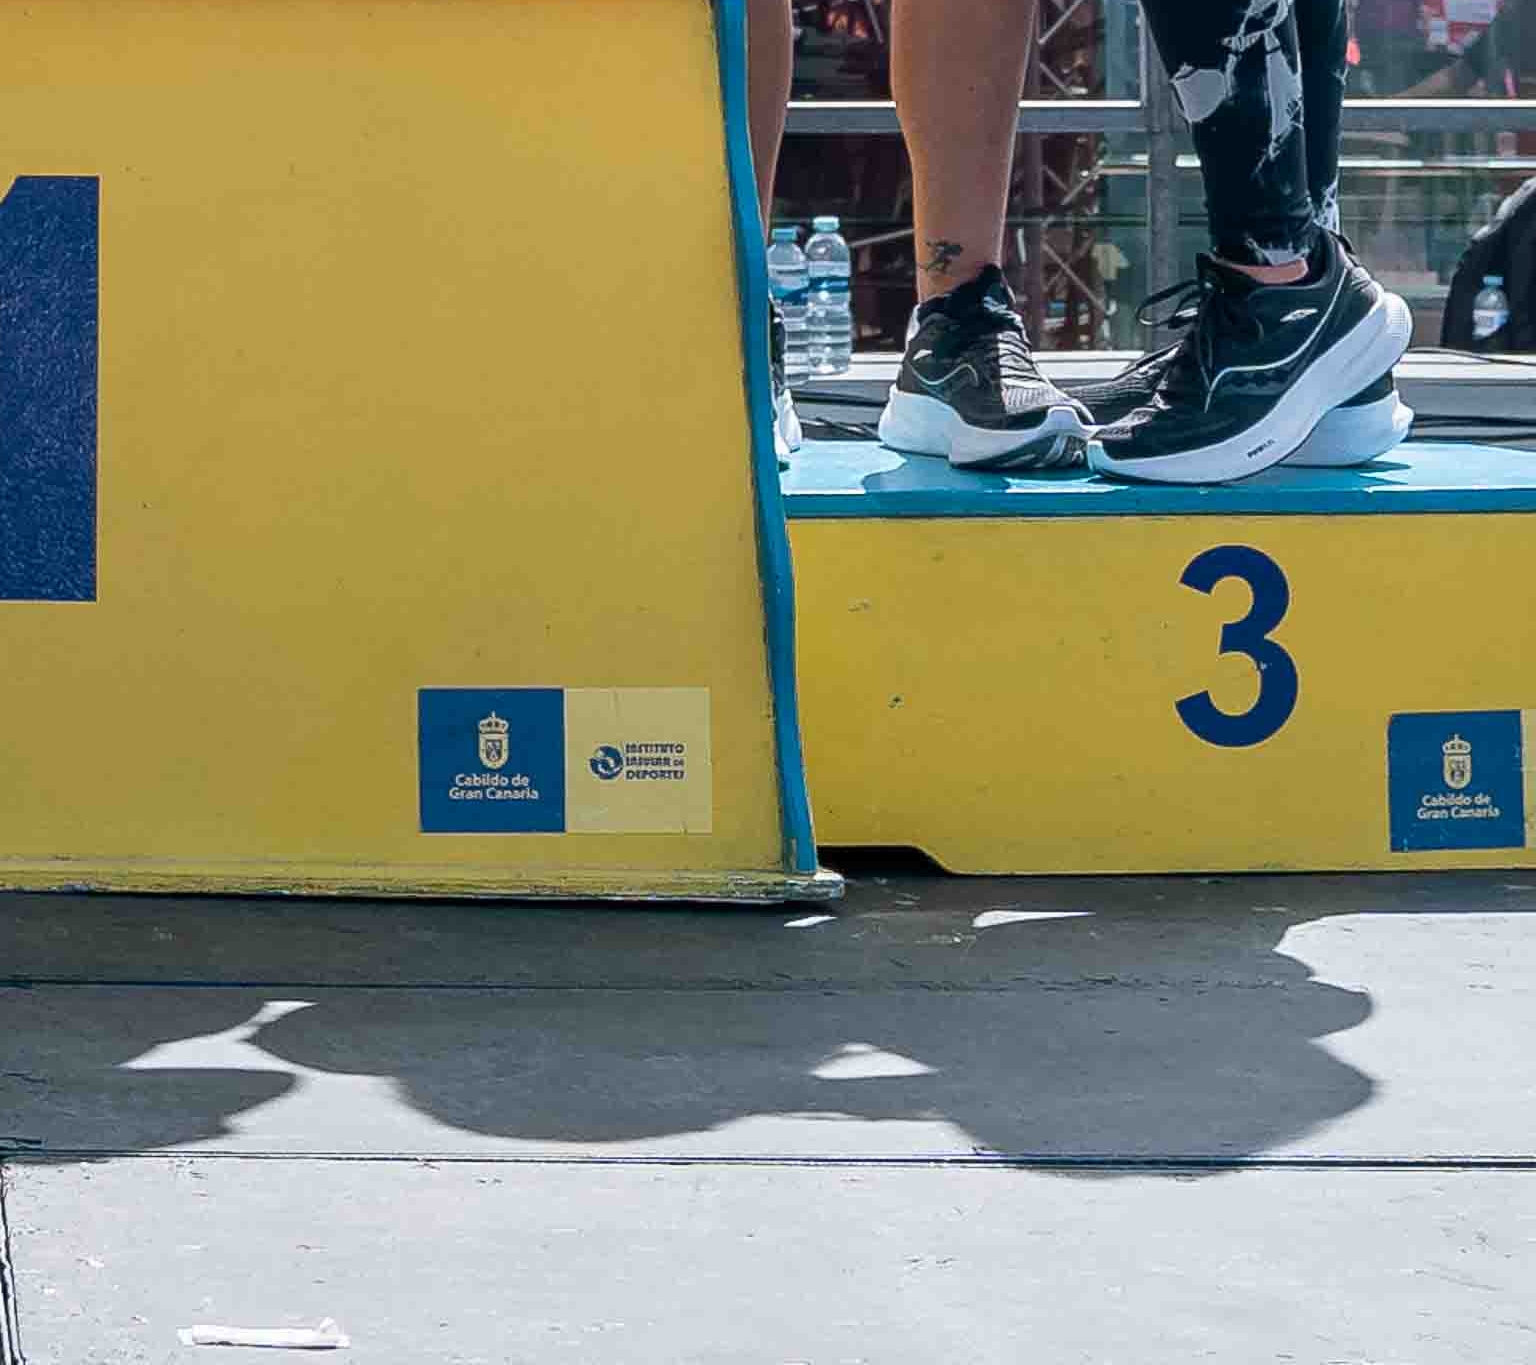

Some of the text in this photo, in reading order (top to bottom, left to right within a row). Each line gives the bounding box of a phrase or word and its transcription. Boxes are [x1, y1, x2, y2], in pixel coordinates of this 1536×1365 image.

[1175, 544, 1299, 747] 3
[455, 772, 530, 787] Cabildo de
[448, 787, 539, 801] Gran Canaria
[1421, 792, 1491, 807] Cabildo de
[1416, 805, 1501, 819] Gran Canaria
